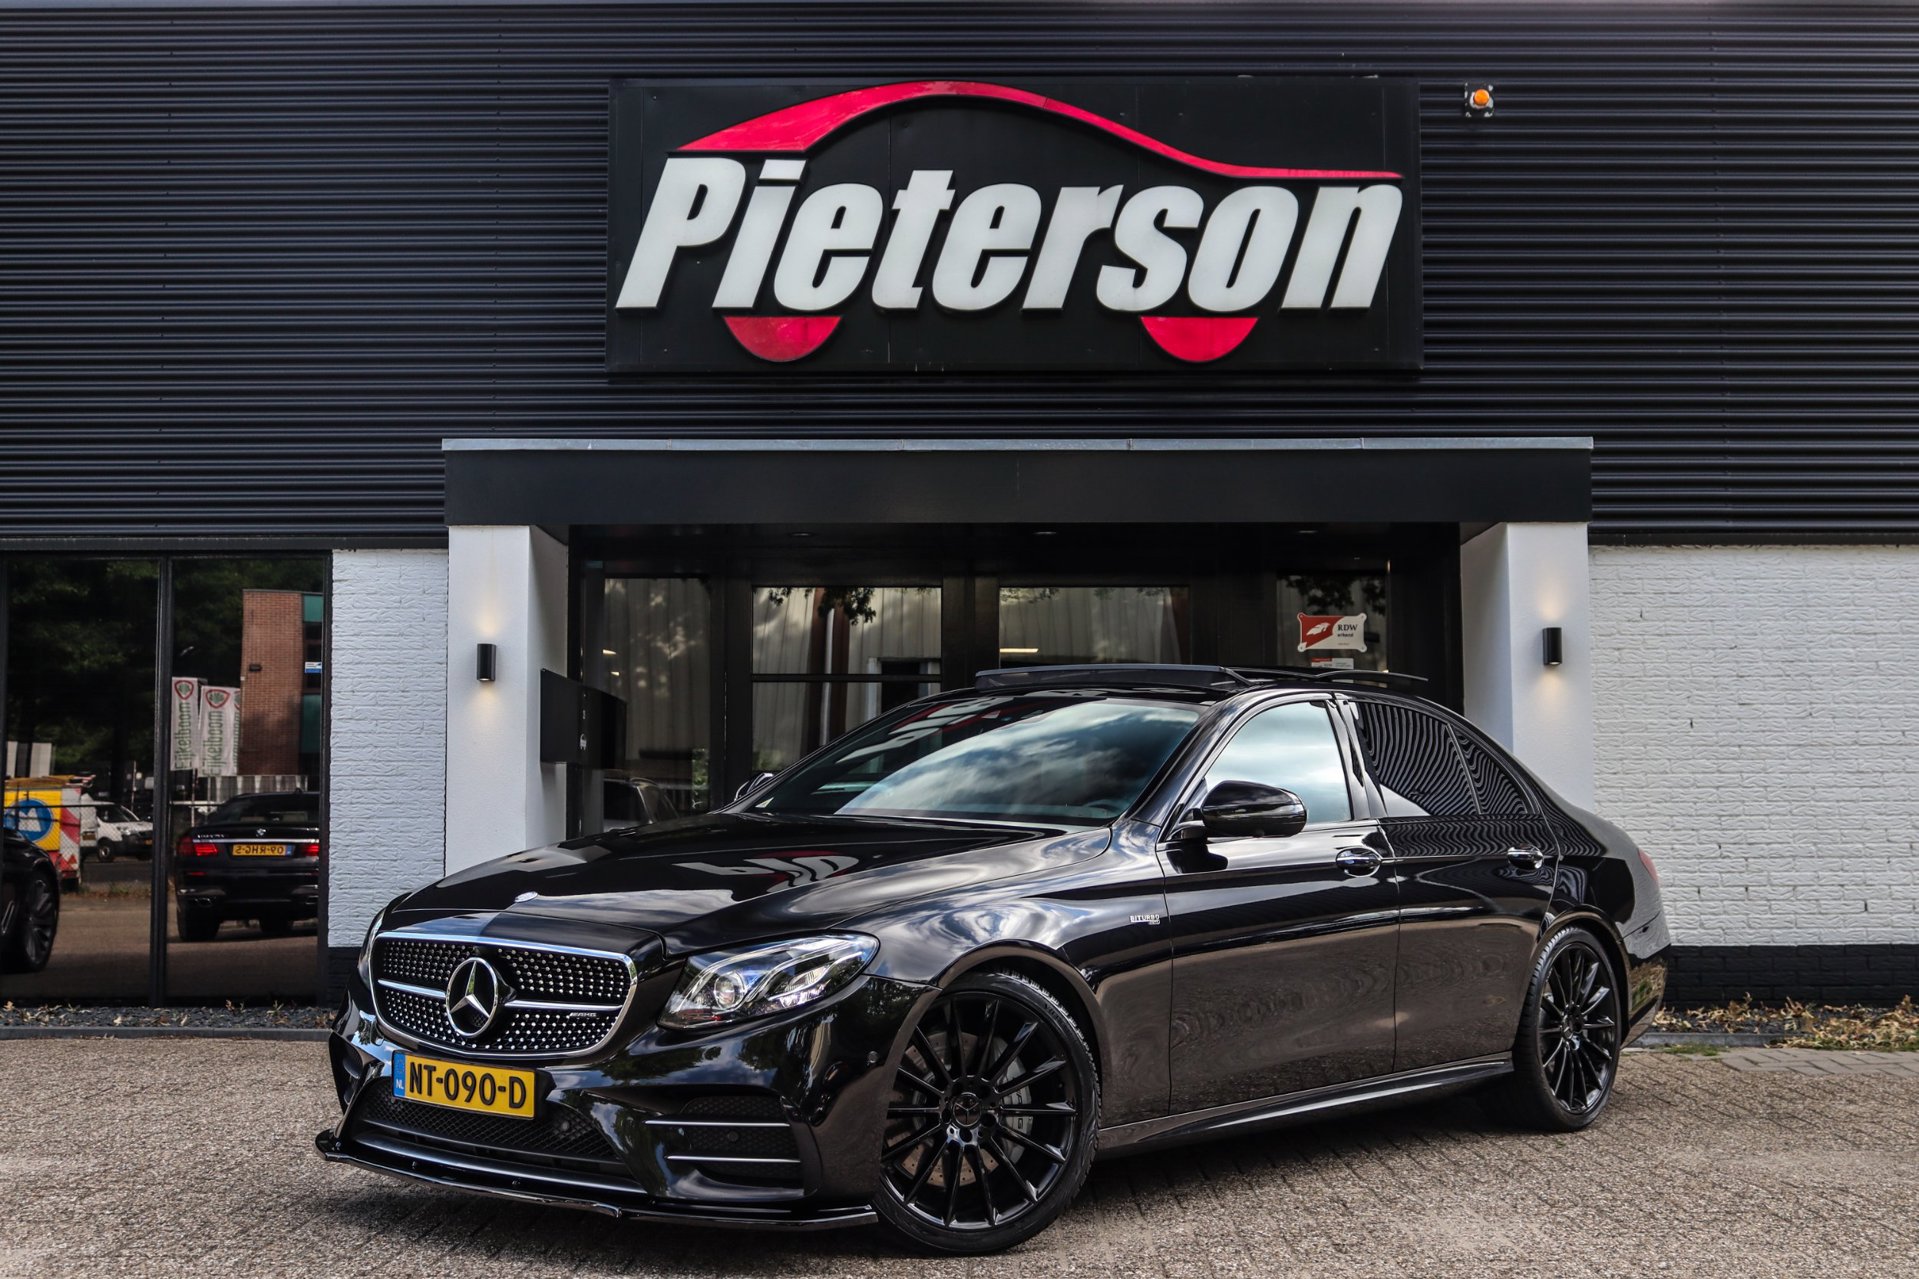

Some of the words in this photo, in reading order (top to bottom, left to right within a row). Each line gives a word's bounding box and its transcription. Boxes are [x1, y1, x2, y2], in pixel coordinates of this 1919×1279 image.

[615, 157, 1403, 313] Pieterson
[1337, 624, 1358, 632] RDW
[174, 702, 196, 769] Eijkelboom
[202, 710, 227, 776] Eijkelboom
[395, 1079, 404, 1090] NL
[409, 1061, 527, 1110] NT-090-D
